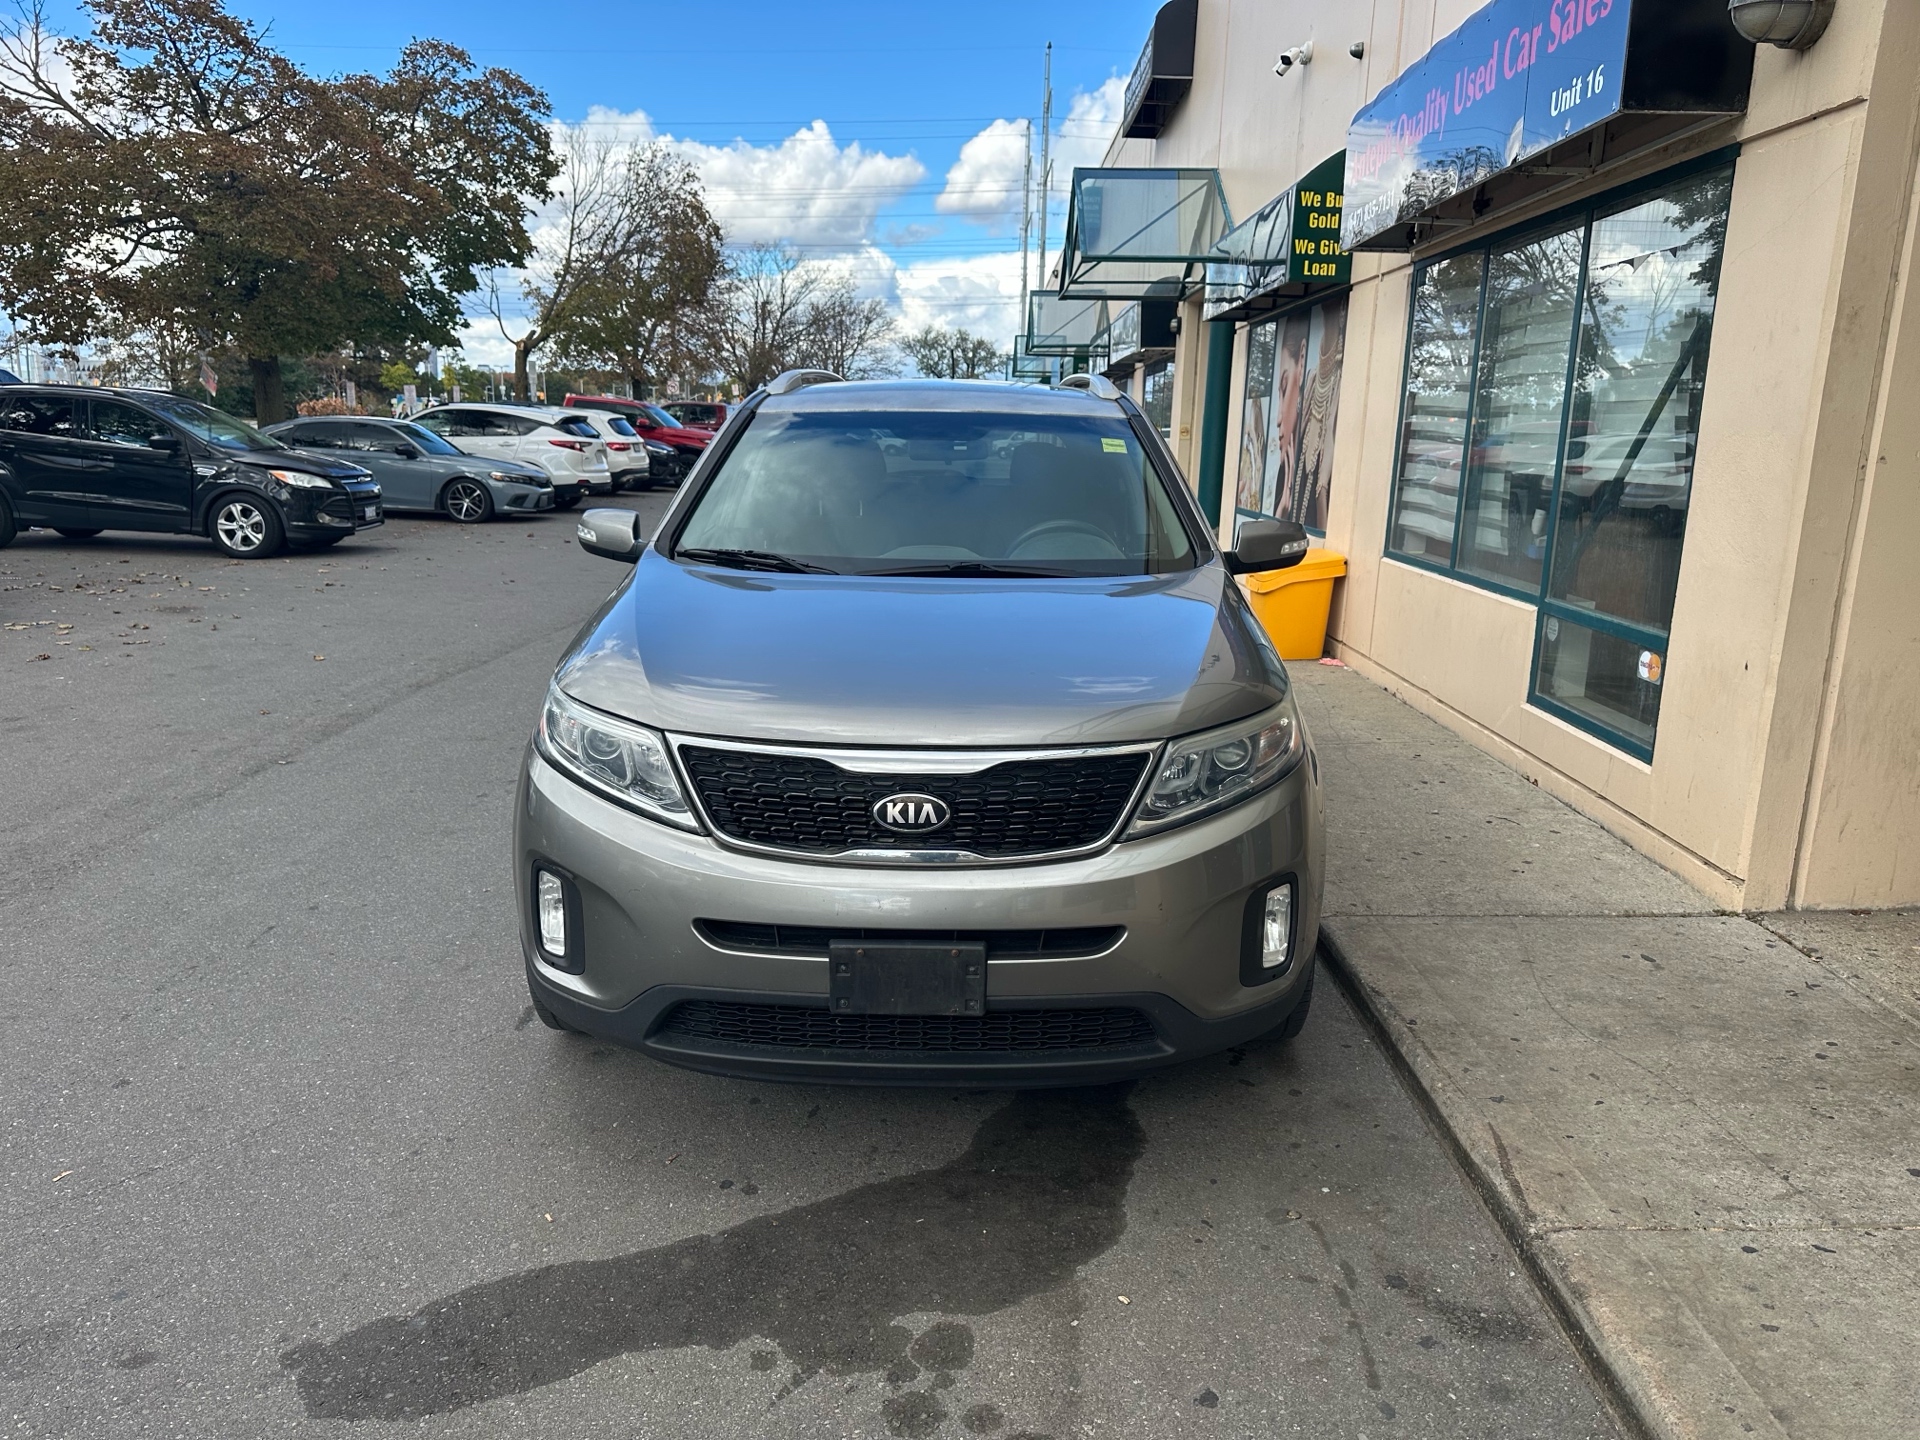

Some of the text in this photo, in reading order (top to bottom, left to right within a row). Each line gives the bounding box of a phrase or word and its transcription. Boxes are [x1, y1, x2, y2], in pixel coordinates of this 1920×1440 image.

[1396, 87, 1450, 161] Quality
[1453, 39, 1499, 116] Used
[1503, 23, 1543, 80] Car
[1547, 0, 1613, 53] Sales
[1550, 64, 1604, 117] Unit 16
[1300, 191, 1343, 208] We Bu
[1309, 212, 1340, 229] Gold
[1294, 238, 1349, 256] We Giv
[1303, 260, 1336, 276] Loan
[886, 802, 938, 824] KIA
